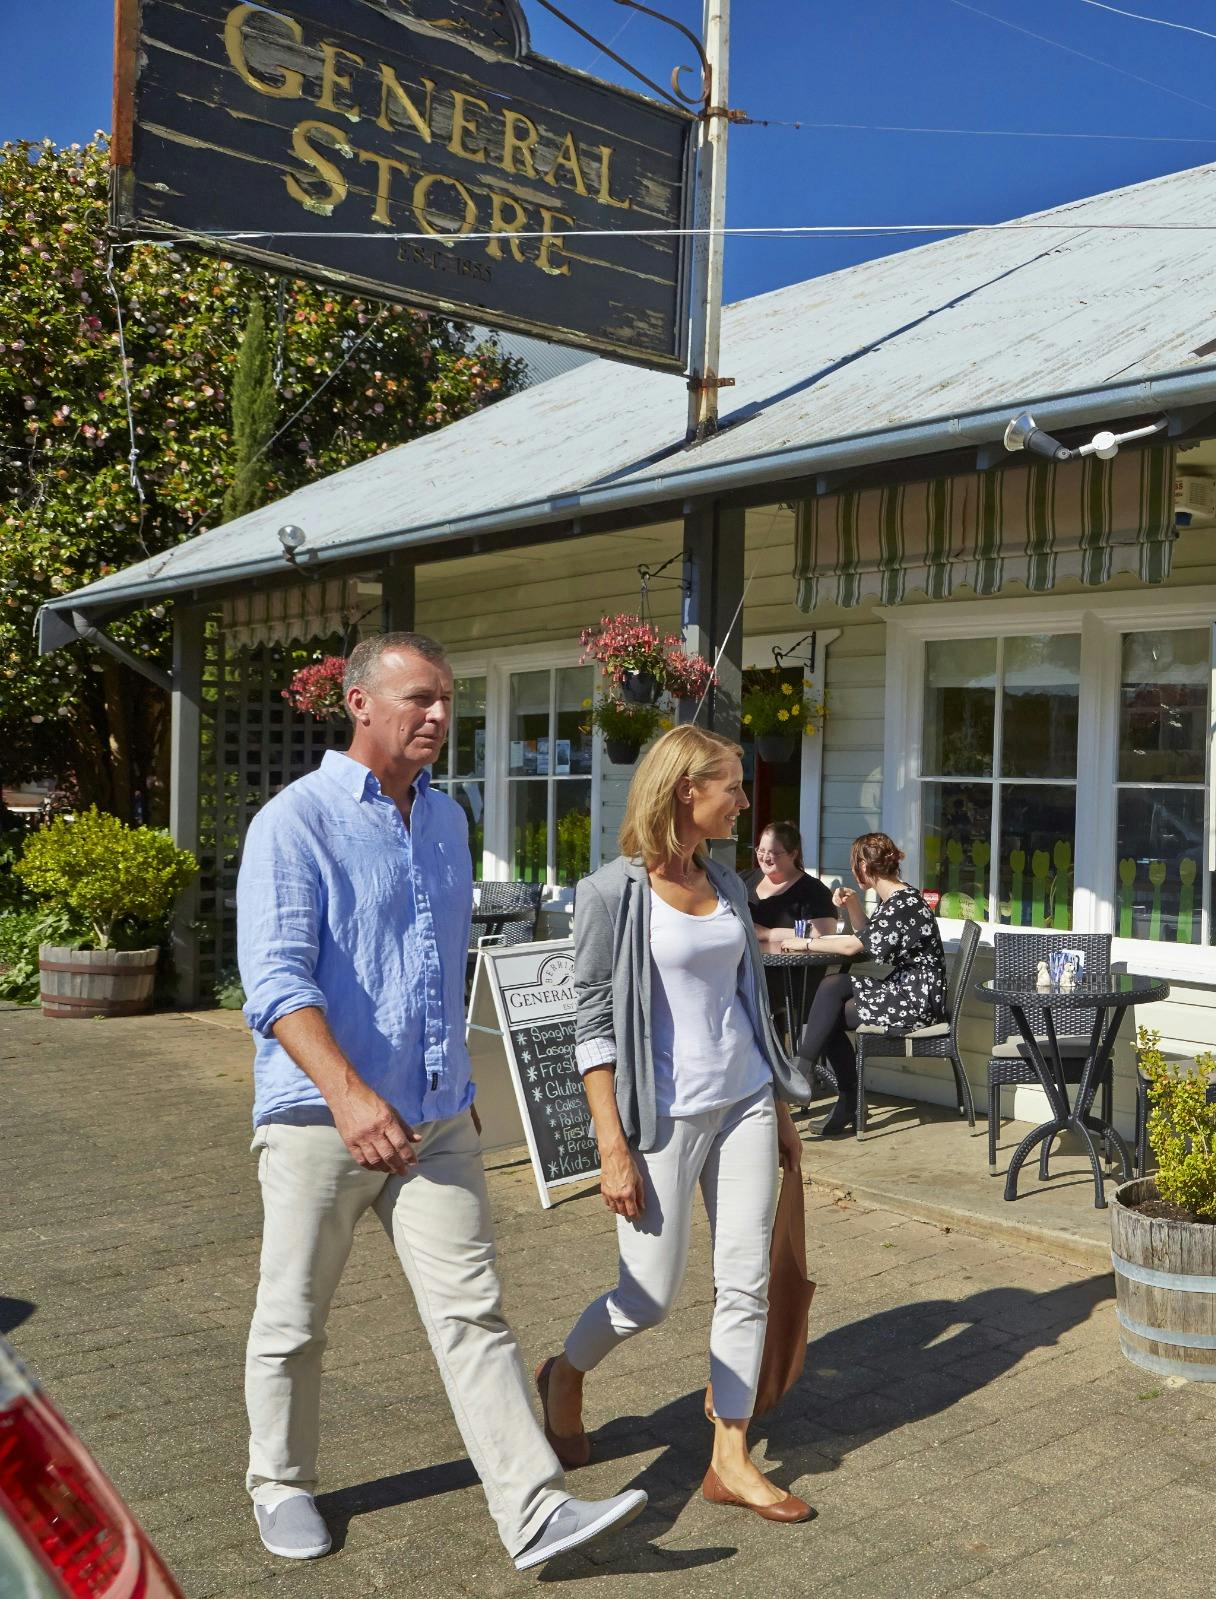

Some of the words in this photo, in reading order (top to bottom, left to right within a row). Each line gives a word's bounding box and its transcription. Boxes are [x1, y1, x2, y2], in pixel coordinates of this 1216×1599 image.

[223, 3, 631, 210] GENERAL
[284, 118, 577, 277] STORE
[510, 987, 578, 1008] GENERAL
[535, 1043, 577, 1058] Lasagn
[545, 1078, 586, 1098] Gluten
[559, 1153, 590, 1176] Kids
